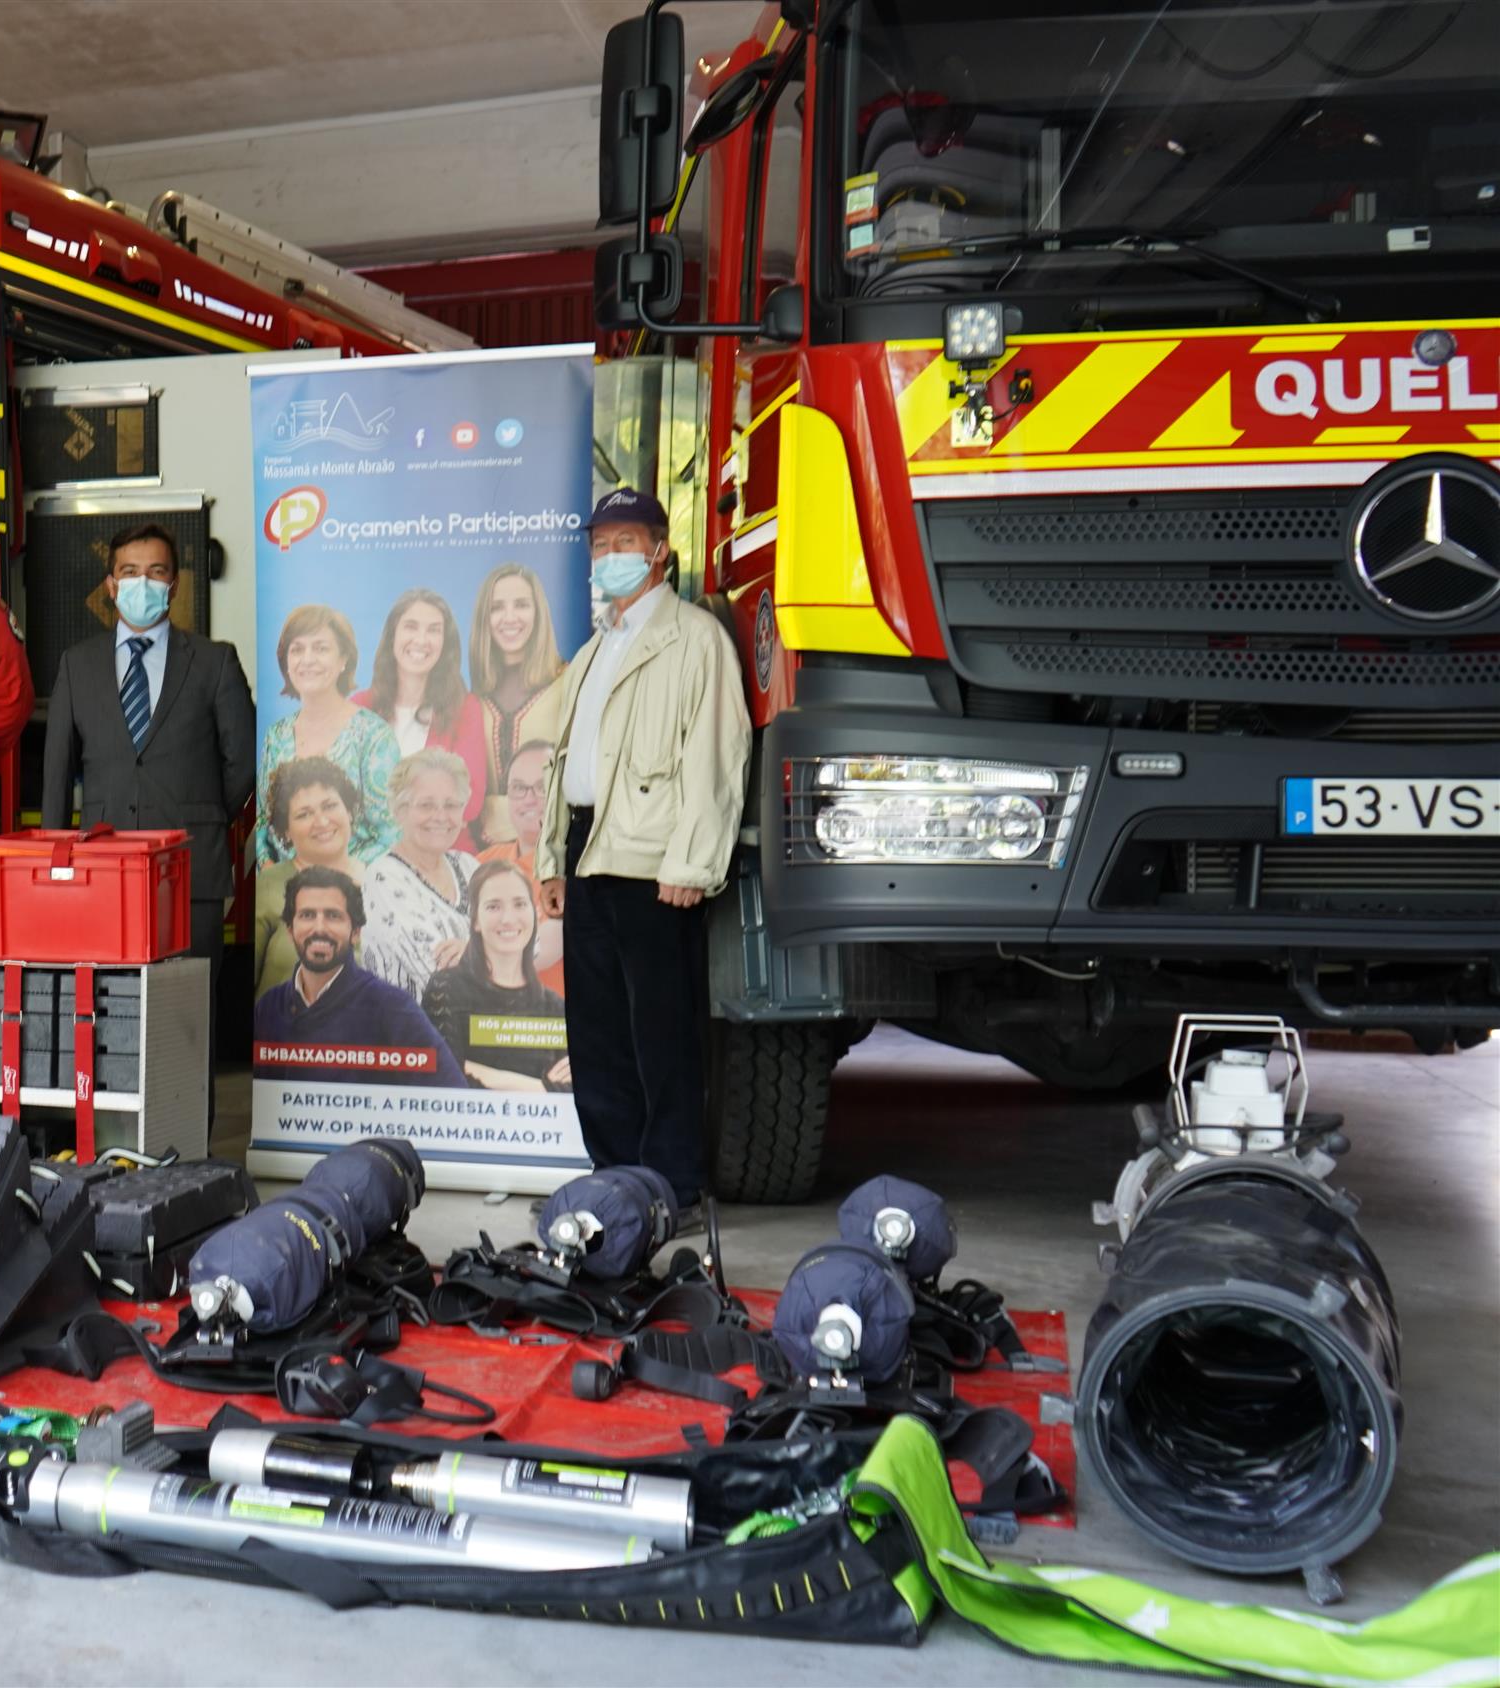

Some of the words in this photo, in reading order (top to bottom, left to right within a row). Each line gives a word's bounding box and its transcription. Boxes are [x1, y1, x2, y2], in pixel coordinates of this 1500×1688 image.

[1255, 354, 1500, 420] QUEL
[321, 461, 355, 474] Monte
[357, 458, 395, 474] Abraão
[321, 514, 443, 543] Orçamento
[448, 509, 581, 536] Participativo
[259, 1047, 375, 1065] EMBAIXADORES
[379, 1052, 401, 1066] DO
[405, 1053, 428, 1067] OP
[282, 1092, 377, 1111] PARTICIPE,
[383, 1099, 394, 1111] A
[399, 1099, 496, 1115] FREGUESIA
[502, 1100, 510, 1115] É
[517, 1105, 558, 1118] SUA!
